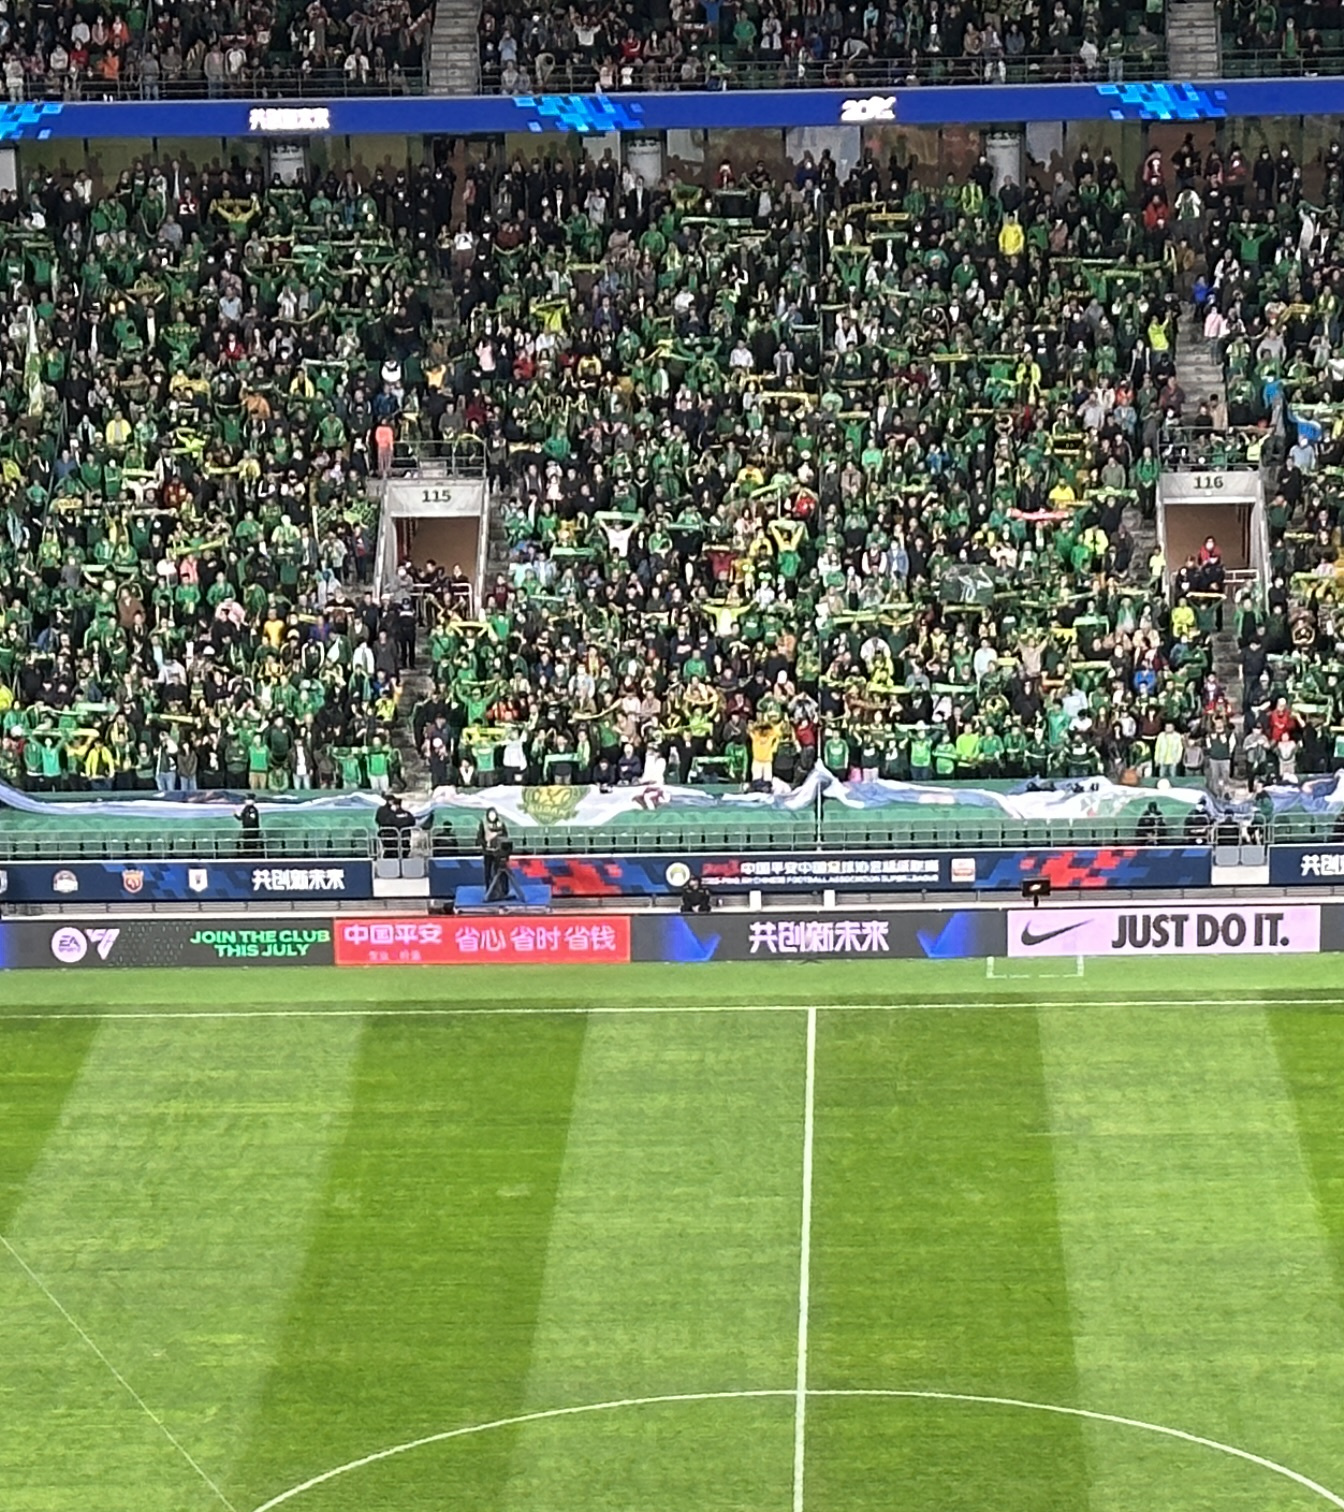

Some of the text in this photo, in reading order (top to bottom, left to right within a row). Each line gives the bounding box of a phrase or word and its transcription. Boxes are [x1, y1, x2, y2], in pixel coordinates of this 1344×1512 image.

[1194, 476, 1224, 489] 116
[422, 490, 452, 503] 115
[252, 867, 346, 892] 共创新未来
[191, 929, 331, 944] JOIN THE CLUB
[344, 924, 443, 945] 中国平安
[455, 925, 616, 953] 省心 省时 省钱
[749, 920, 890, 953] 共创新未来
[1112, 912, 1290, 948] JUST DO IT.
[58, 935, 80, 947] EA
[215, 943, 309, 957] THIS JULY
